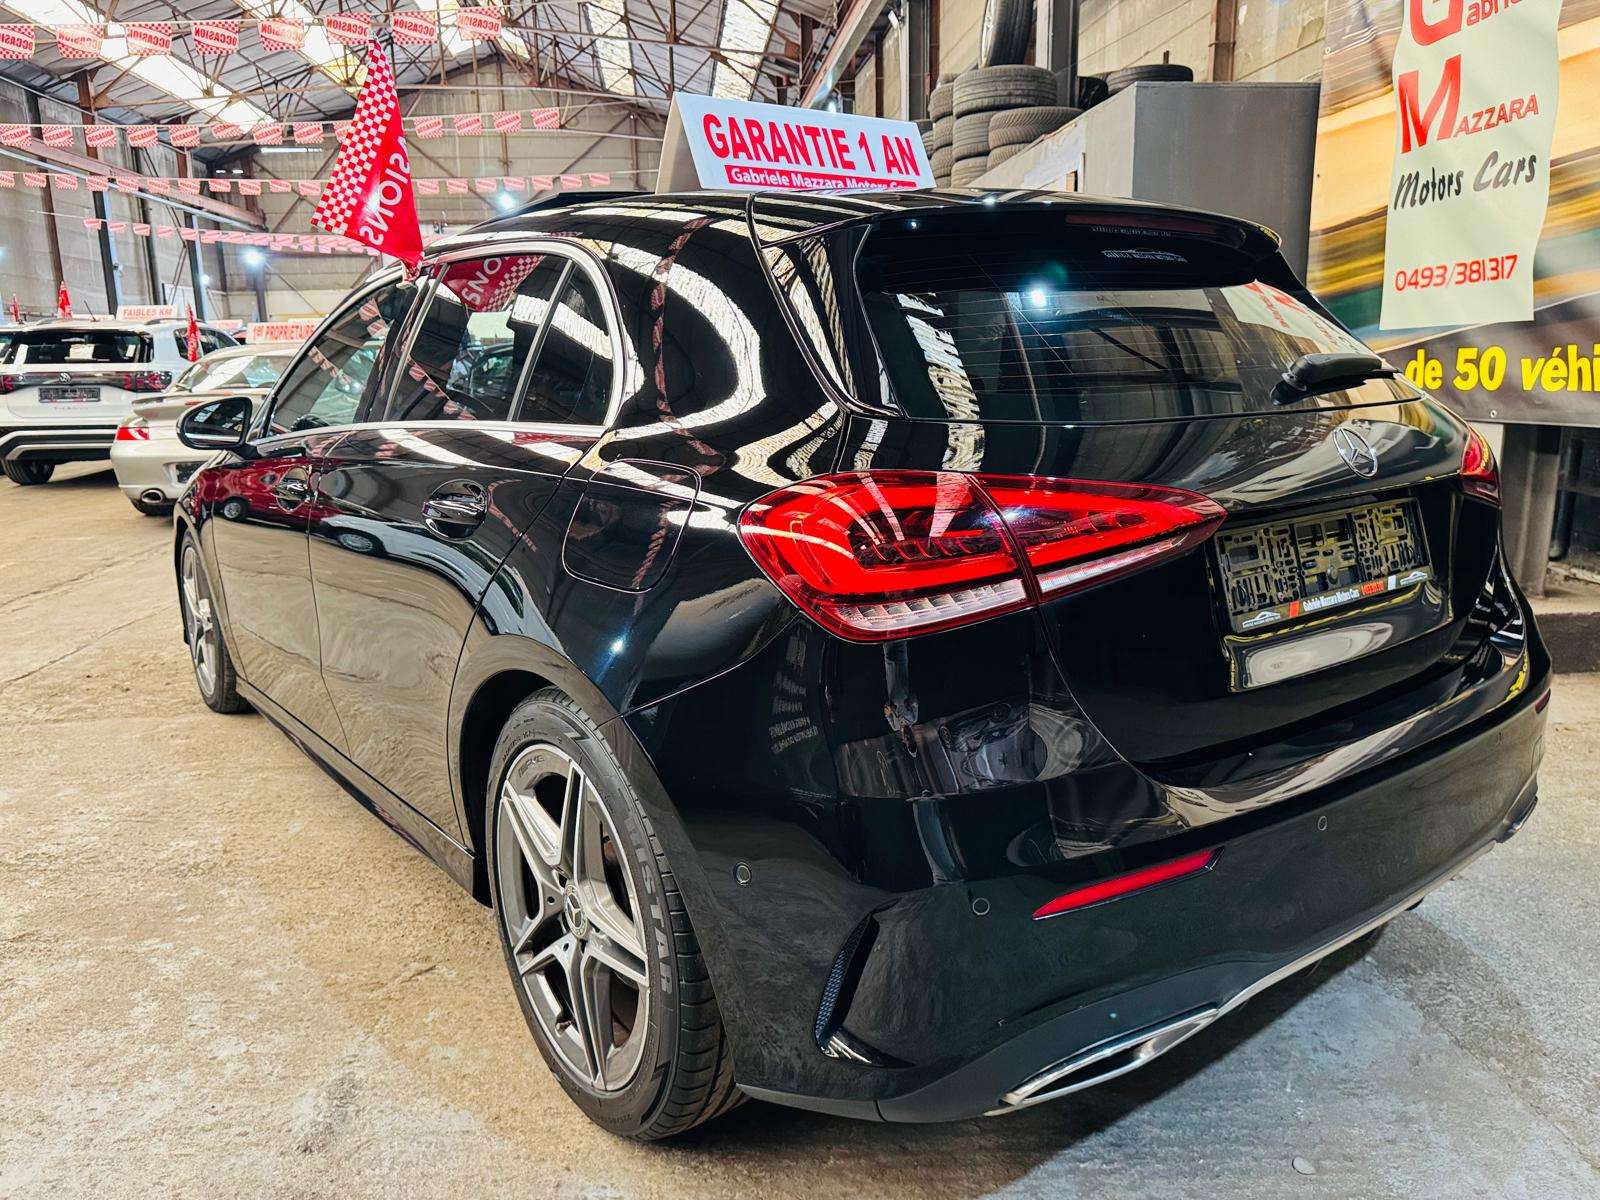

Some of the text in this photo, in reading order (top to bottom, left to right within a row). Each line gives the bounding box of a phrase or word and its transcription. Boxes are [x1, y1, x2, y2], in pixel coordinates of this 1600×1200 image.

[1397, 54, 1538, 154] MAZZARA
[702, 113, 921, 177] GARANTIE 1 AN
[731, 168, 789, 185] Gabriele
[791, 173, 844, 188] Mazzara
[1394, 150, 1537, 210] Motors Cars
[1394, 254, 1519, 292] 0493/381.317
[123, 308, 173, 316] FAIBLES KM
[1405, 348, 1443, 390] de
[1452, 345, 1507, 391] 50
